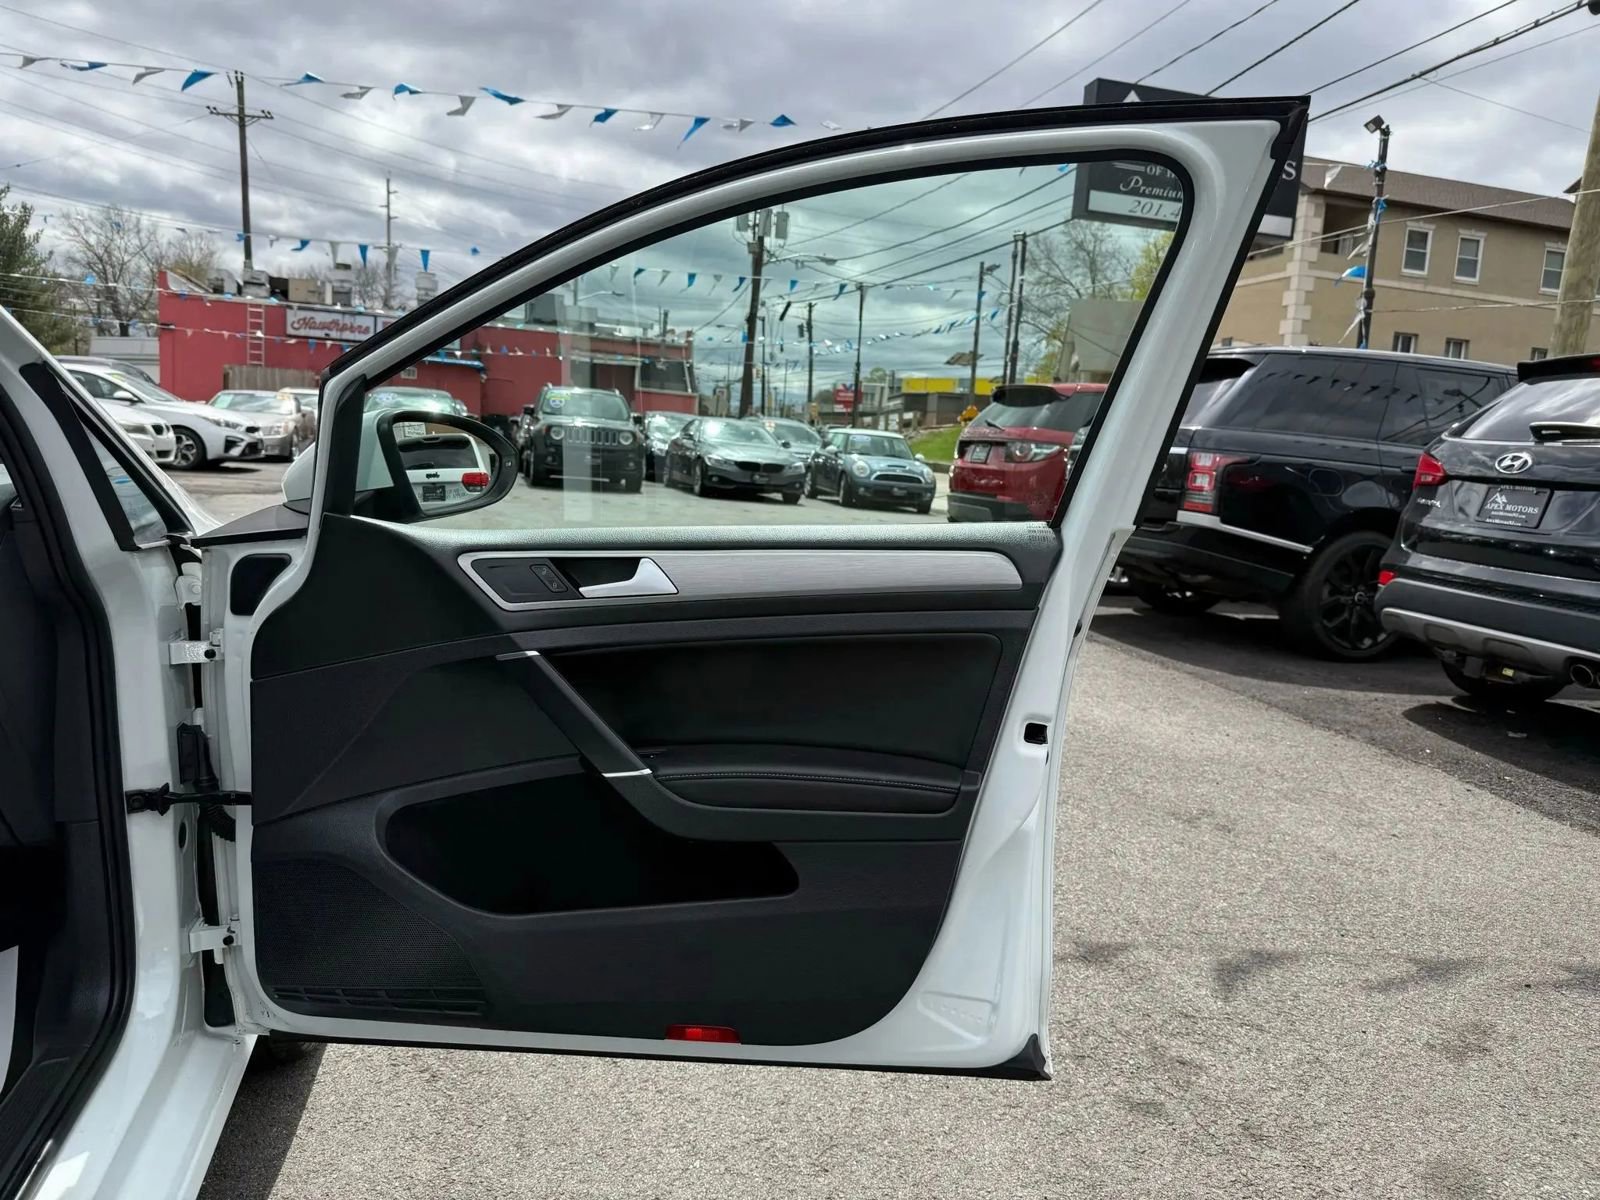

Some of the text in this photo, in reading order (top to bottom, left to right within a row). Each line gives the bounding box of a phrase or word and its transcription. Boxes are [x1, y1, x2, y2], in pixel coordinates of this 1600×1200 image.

[1146, 164, 1163, 176] OF
[291, 316, 370, 334] Hawthorne
[1505, 504, 1539, 514] MOTORS
